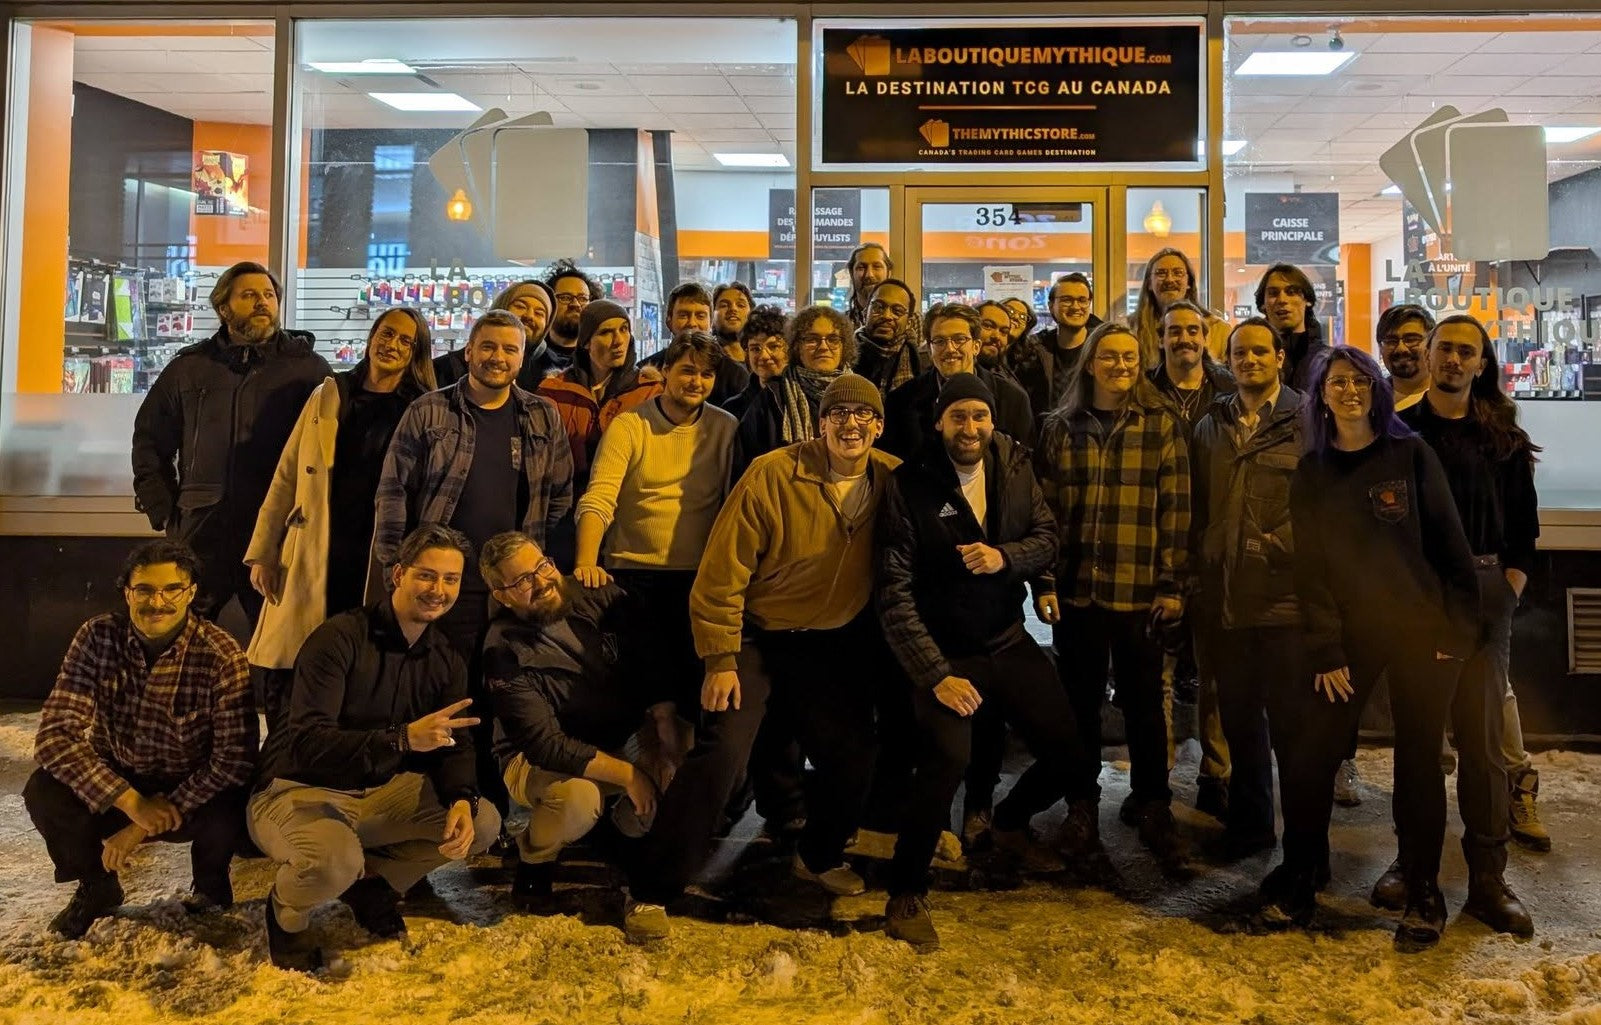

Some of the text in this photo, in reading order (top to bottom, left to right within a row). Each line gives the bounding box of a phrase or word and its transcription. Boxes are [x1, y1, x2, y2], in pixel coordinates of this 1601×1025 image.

[845, 80, 1172, 95] LA DESTINATION TCG AU CANADA
[777, 218, 794, 226] DES
[976, 207, 1022, 227] 354
[1272, 218, 1310, 228] CAISSE
[1261, 231, 1325, 241] PRINCIPALE
[430, 258, 468, 281] LA
[1385, 259, 1427, 283] LA
[1436, 261, 1471, 272] L'UNITÉ
[1404, 287, 1574, 313] BOUTIQUE
